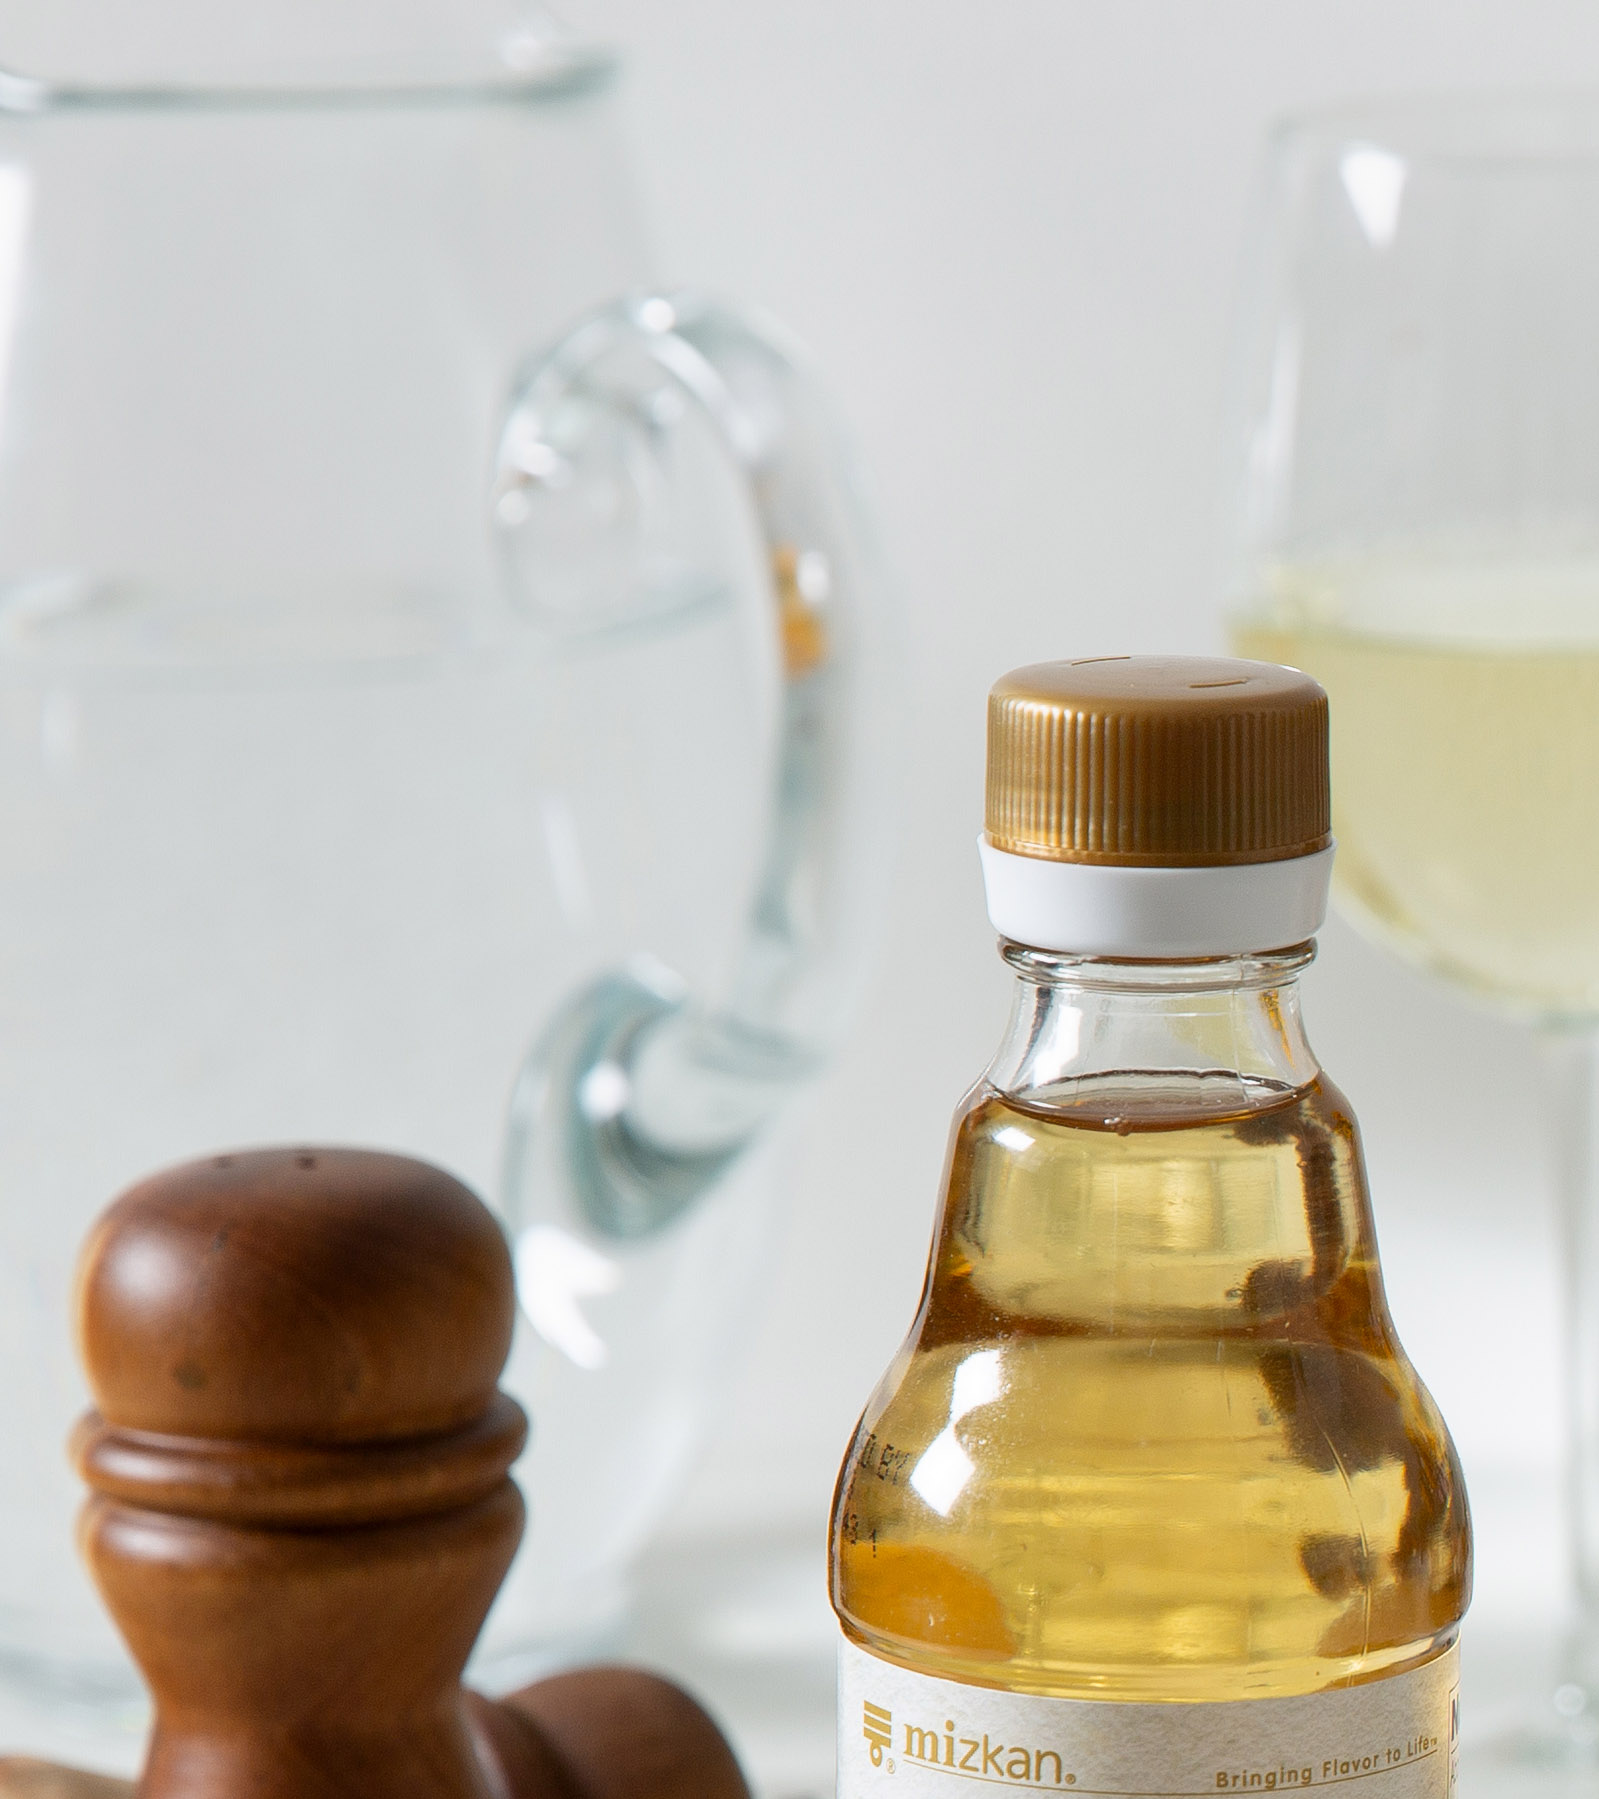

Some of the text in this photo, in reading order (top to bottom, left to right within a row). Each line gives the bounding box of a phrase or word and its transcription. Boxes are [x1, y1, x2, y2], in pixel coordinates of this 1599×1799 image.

[1216, 1766, 1312, 1790] Bringing
[1322, 1752, 1379, 1778] Flavor
[1386, 1748, 1401, 1764] to
